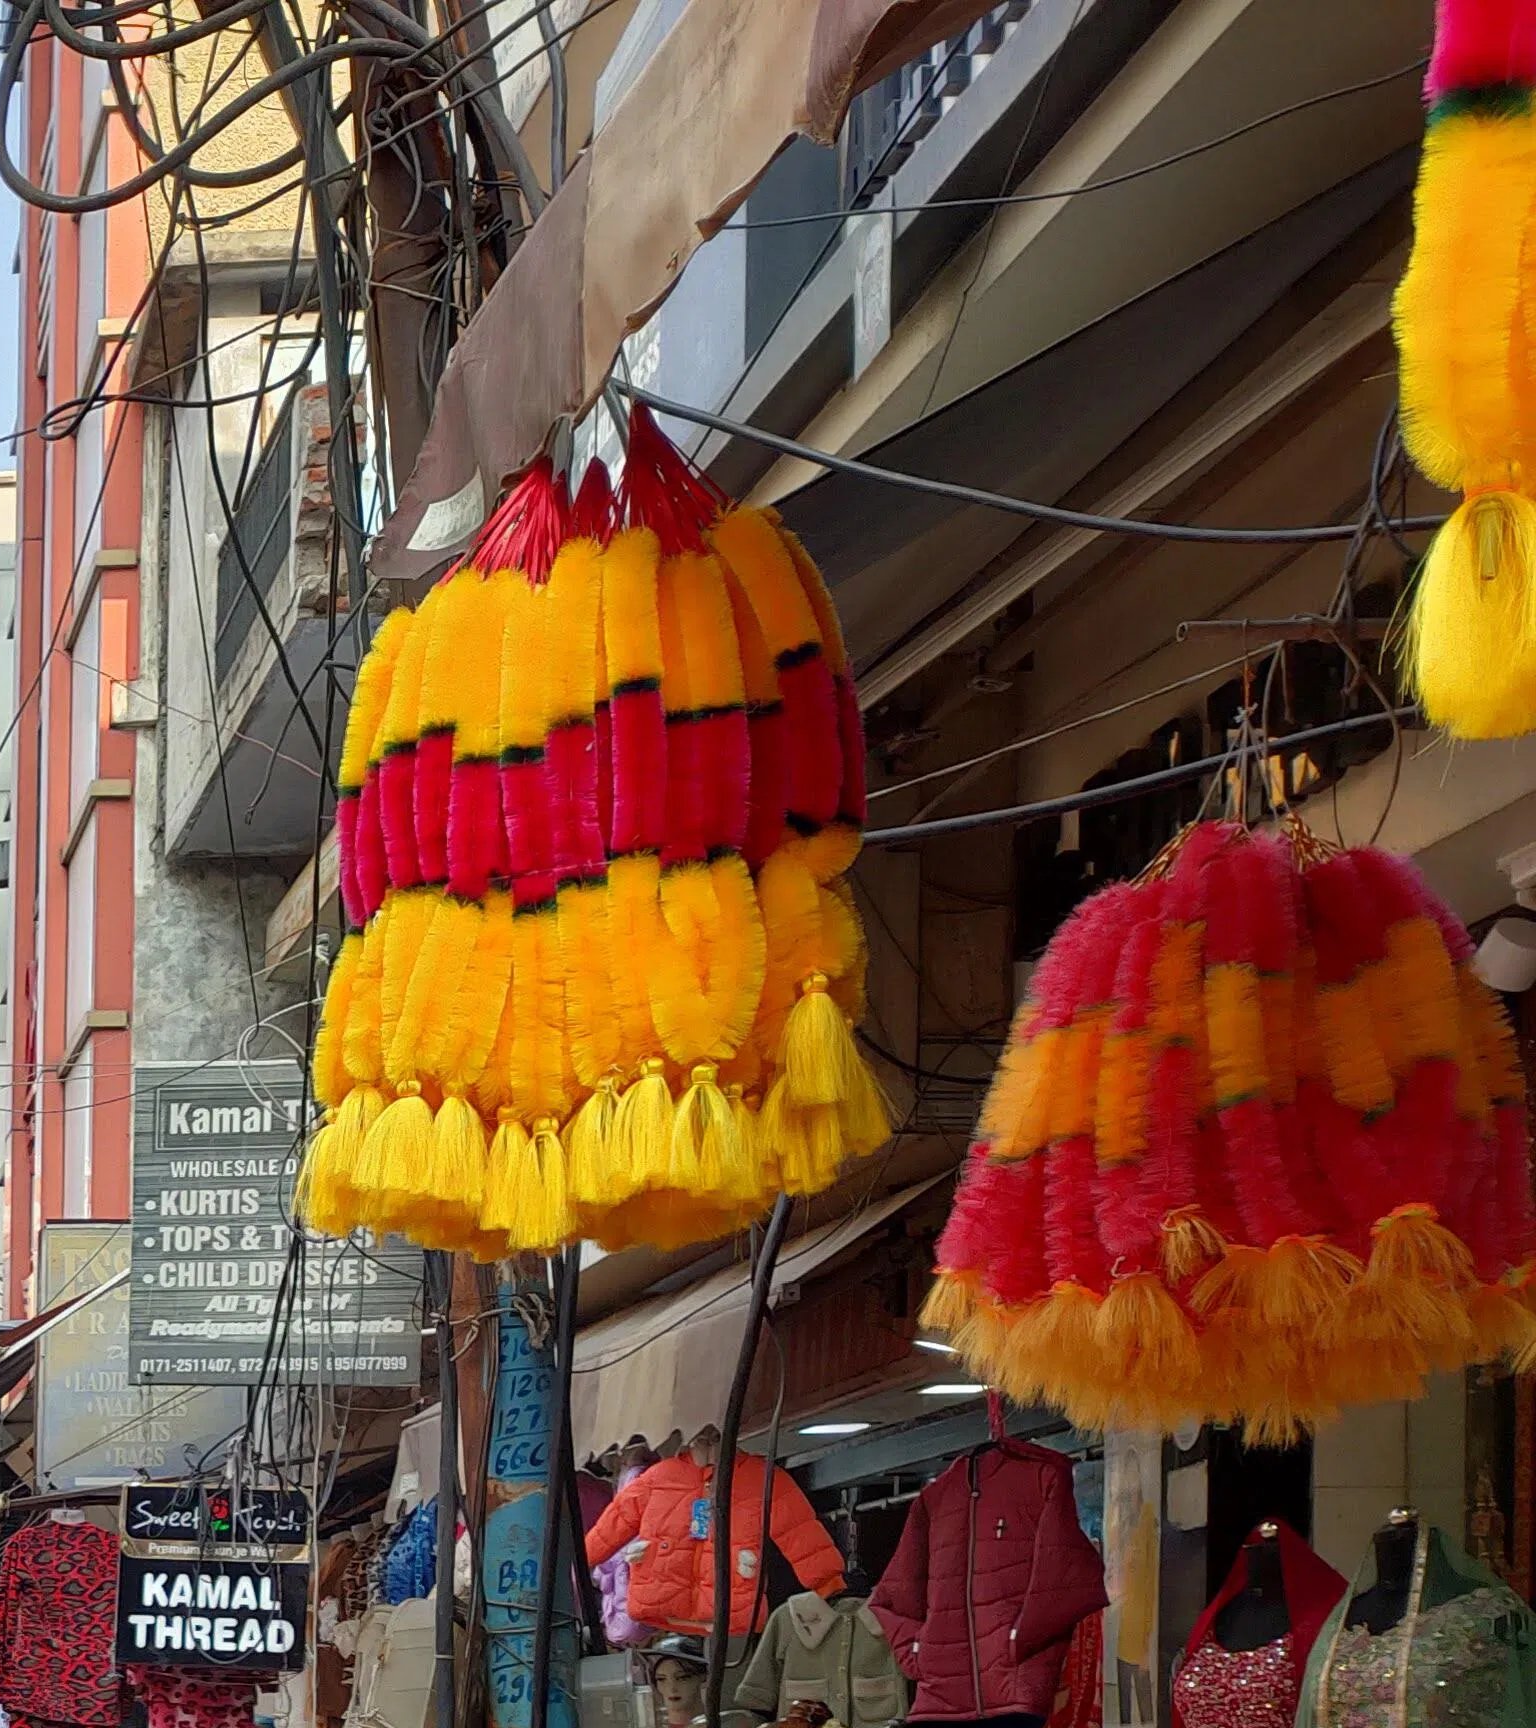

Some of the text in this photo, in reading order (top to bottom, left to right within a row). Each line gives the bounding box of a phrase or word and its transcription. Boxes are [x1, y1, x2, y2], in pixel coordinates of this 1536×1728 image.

[169, 1101, 273, 1134] Kamal
[170, 1159, 280, 1178] WHOLESALE
[160, 1189, 260, 1216] KURTIS
[160, 1226, 230, 1252] TOPS
[240, 1225, 261, 1250] &
[159, 1262, 239, 1288] CHILD
[204, 1295, 240, 1312] All
[132, 1500, 200, 1529] Sweet
[148, 1542, 199, 1555] Premium
[142, 1572, 280, 1611] KAMAL
[128, 1614, 295, 1654] THREAD
